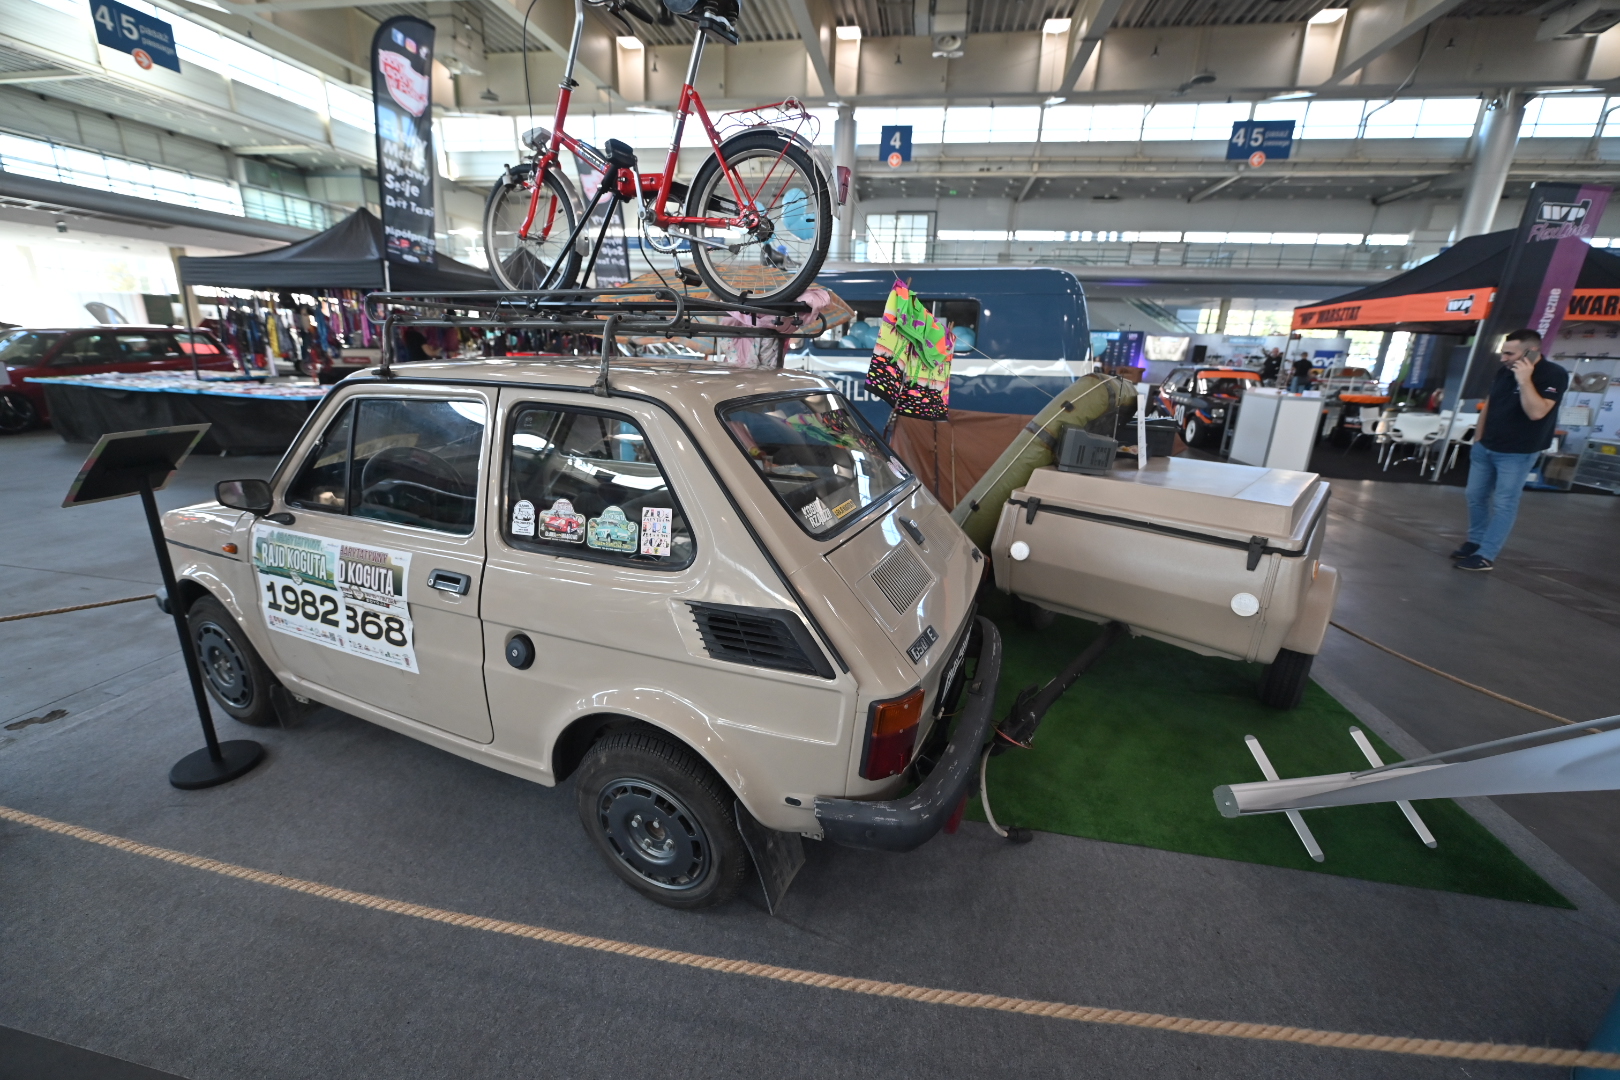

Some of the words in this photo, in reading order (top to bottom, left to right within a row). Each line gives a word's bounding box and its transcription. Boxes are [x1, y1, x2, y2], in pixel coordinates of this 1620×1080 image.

[95, 5, 114, 31] 4
[121, 13, 139, 40] 5
[890, 131, 901, 149] 4
[1232, 128, 1245, 147] 4
[1250, 127, 1264, 147] 5
[1542, 205, 1586, 221] WP
[1315, 305, 1363, 324] WARSZTAT
[1447, 298, 1475, 313] WP
[1568, 295, 1620, 315] WAR
[261, 543, 285, 568] RAJD
[287, 547, 327, 581] KOGUTA
[348, 561, 394, 597] KOGUTA
[266, 581, 340, 628] 1982
[910, 635, 928, 661] 650
[926, 627, 936, 642] E
